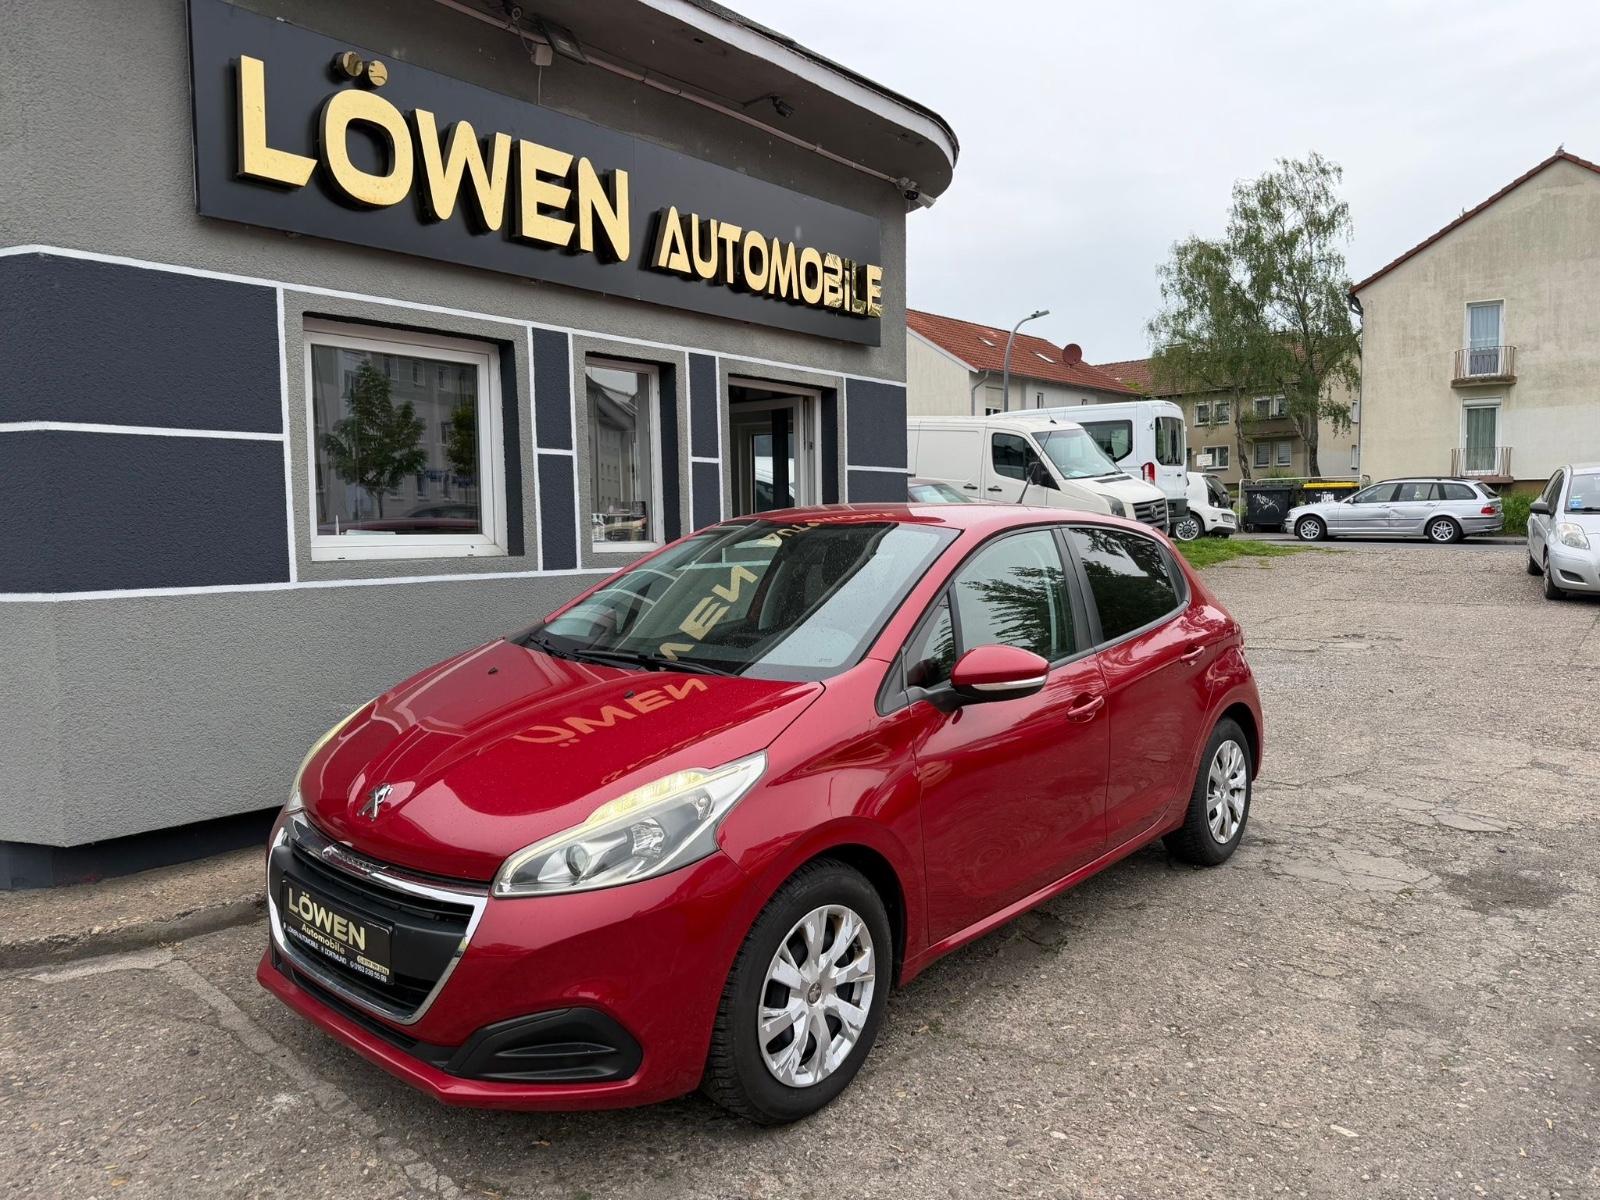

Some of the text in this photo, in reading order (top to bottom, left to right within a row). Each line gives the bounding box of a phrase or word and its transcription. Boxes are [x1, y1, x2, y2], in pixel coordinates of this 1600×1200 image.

[236, 51, 629, 262] LÖWEN
[288, 888, 365, 950] LÖWEN
[301, 923, 345, 955] Automobile
